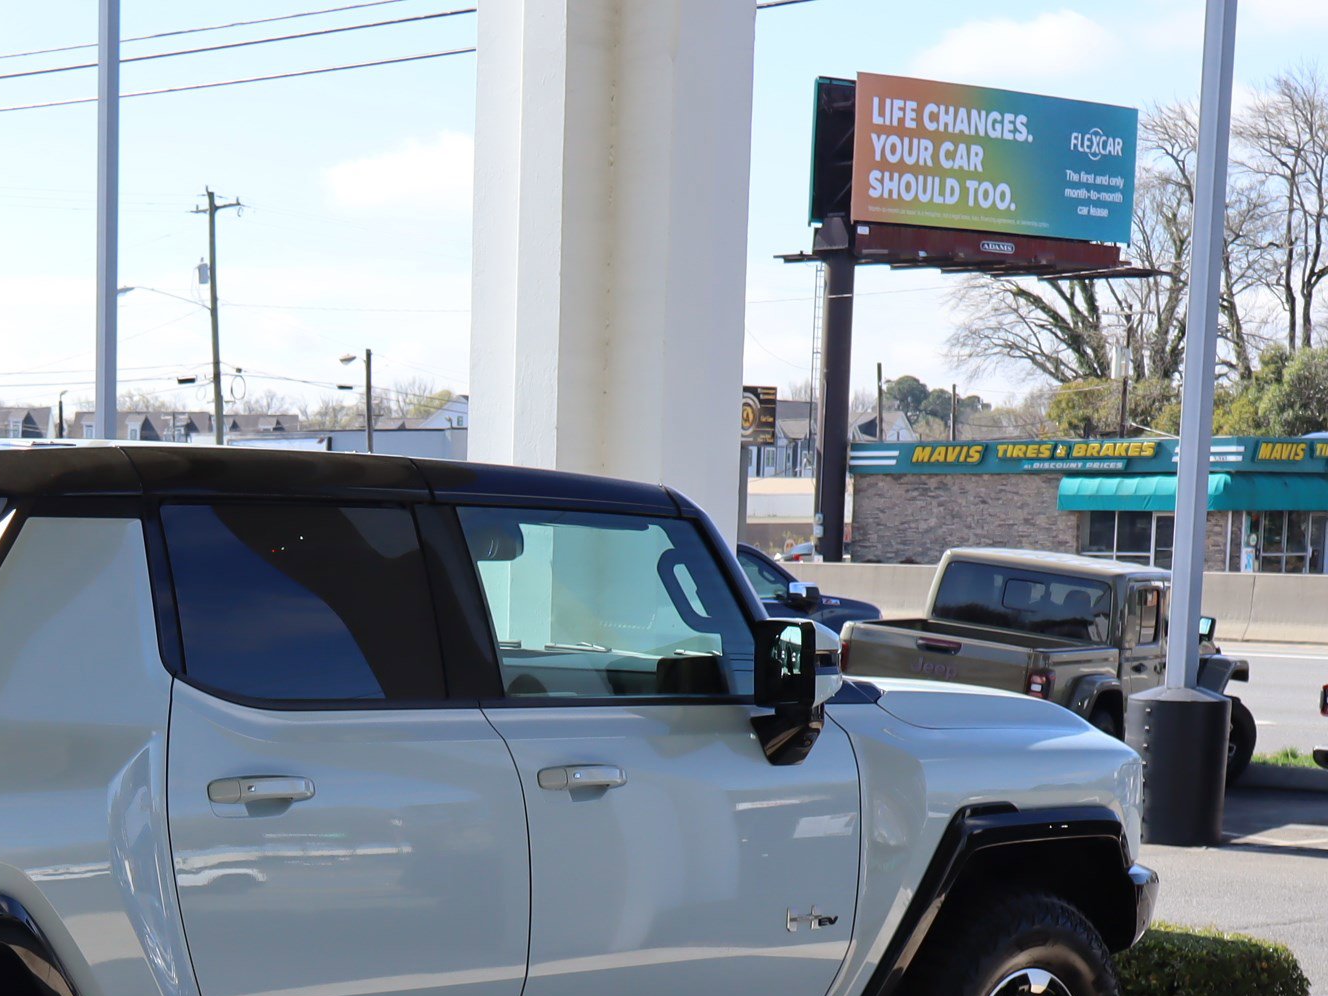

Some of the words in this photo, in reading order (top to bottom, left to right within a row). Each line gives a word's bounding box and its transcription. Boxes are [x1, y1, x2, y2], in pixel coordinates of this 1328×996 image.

[872, 96, 917, 128] LIFE
[923, 103, 1033, 143] CHANGES.
[870, 132, 934, 167] YOUR
[939, 141, 984, 172] CAR
[1070, 131, 1124, 158] FLEXCAR
[1066, 169, 1080, 182] The
[1080, 171, 1095, 184] first
[1095, 174, 1109, 186] and
[1109, 176, 1124, 189] only
[868, 169, 960, 204] SHOULD
[966, 179, 1016, 211] TOO.
[1064, 187, 1123, 203] month-to-month
[1077, 206, 1089, 216] car
[1089, 204, 1109, 217] lease
[982, 243, 1013, 252] ADAMS
[912, 444, 984, 463] MAVIS
[996, 444, 1052, 458] TIRES
[1072, 442, 1156, 457] BRAKES
[1258, 442, 1307, 461] MAVIS
[1085, 461, 1123, 469] PRICES
